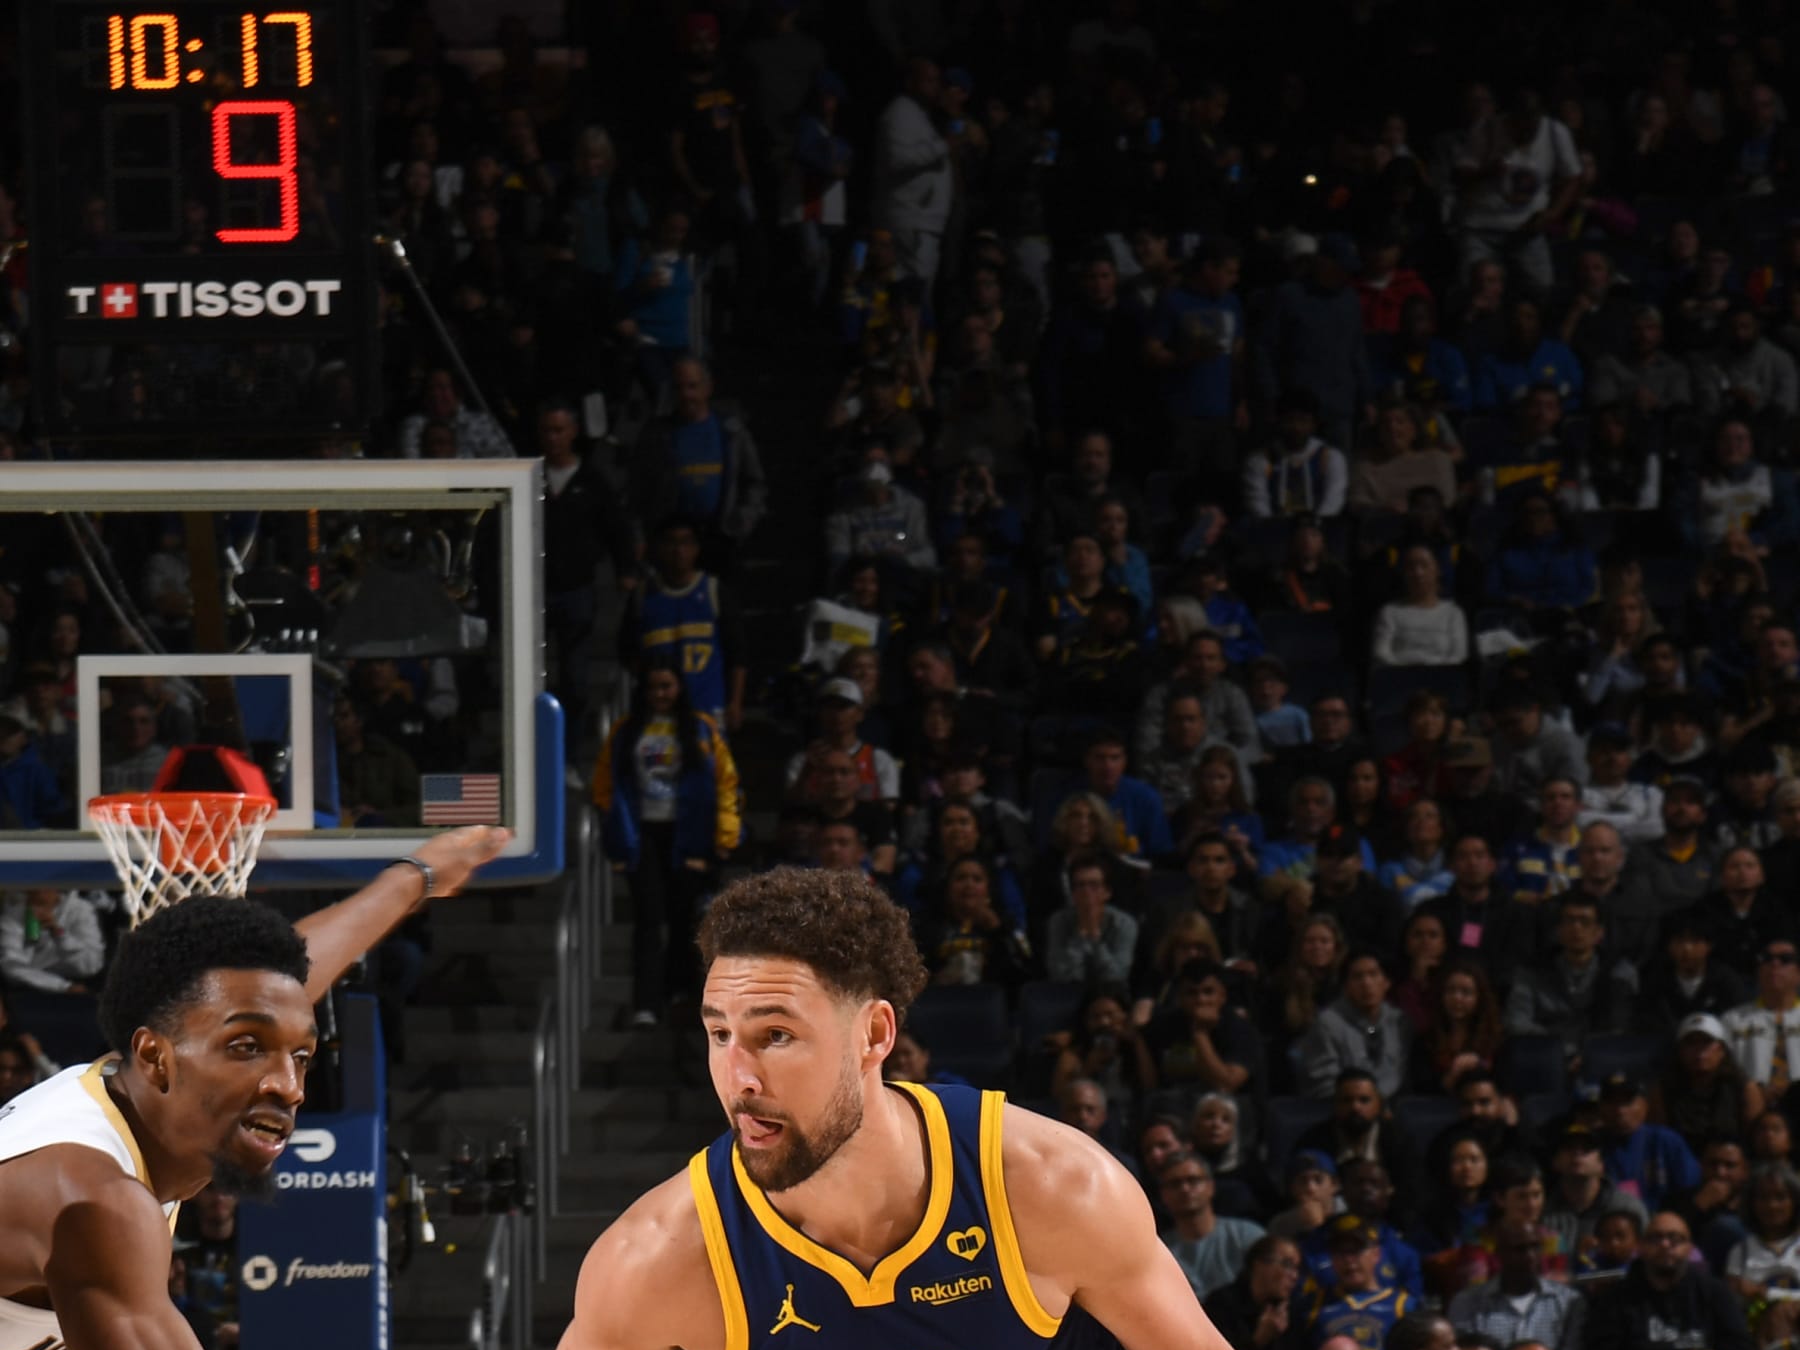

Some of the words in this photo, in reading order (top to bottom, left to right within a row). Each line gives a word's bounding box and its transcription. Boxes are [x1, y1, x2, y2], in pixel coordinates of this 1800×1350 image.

[109, 13, 313, 90] 10:17
[212, 100, 299, 243] 9
[143, 280, 341, 319] TISSOT
[277, 1172, 376, 1190] ORDASH
[285, 1258, 372, 1287] freedom
[910, 1275, 993, 1304] Rakuten
